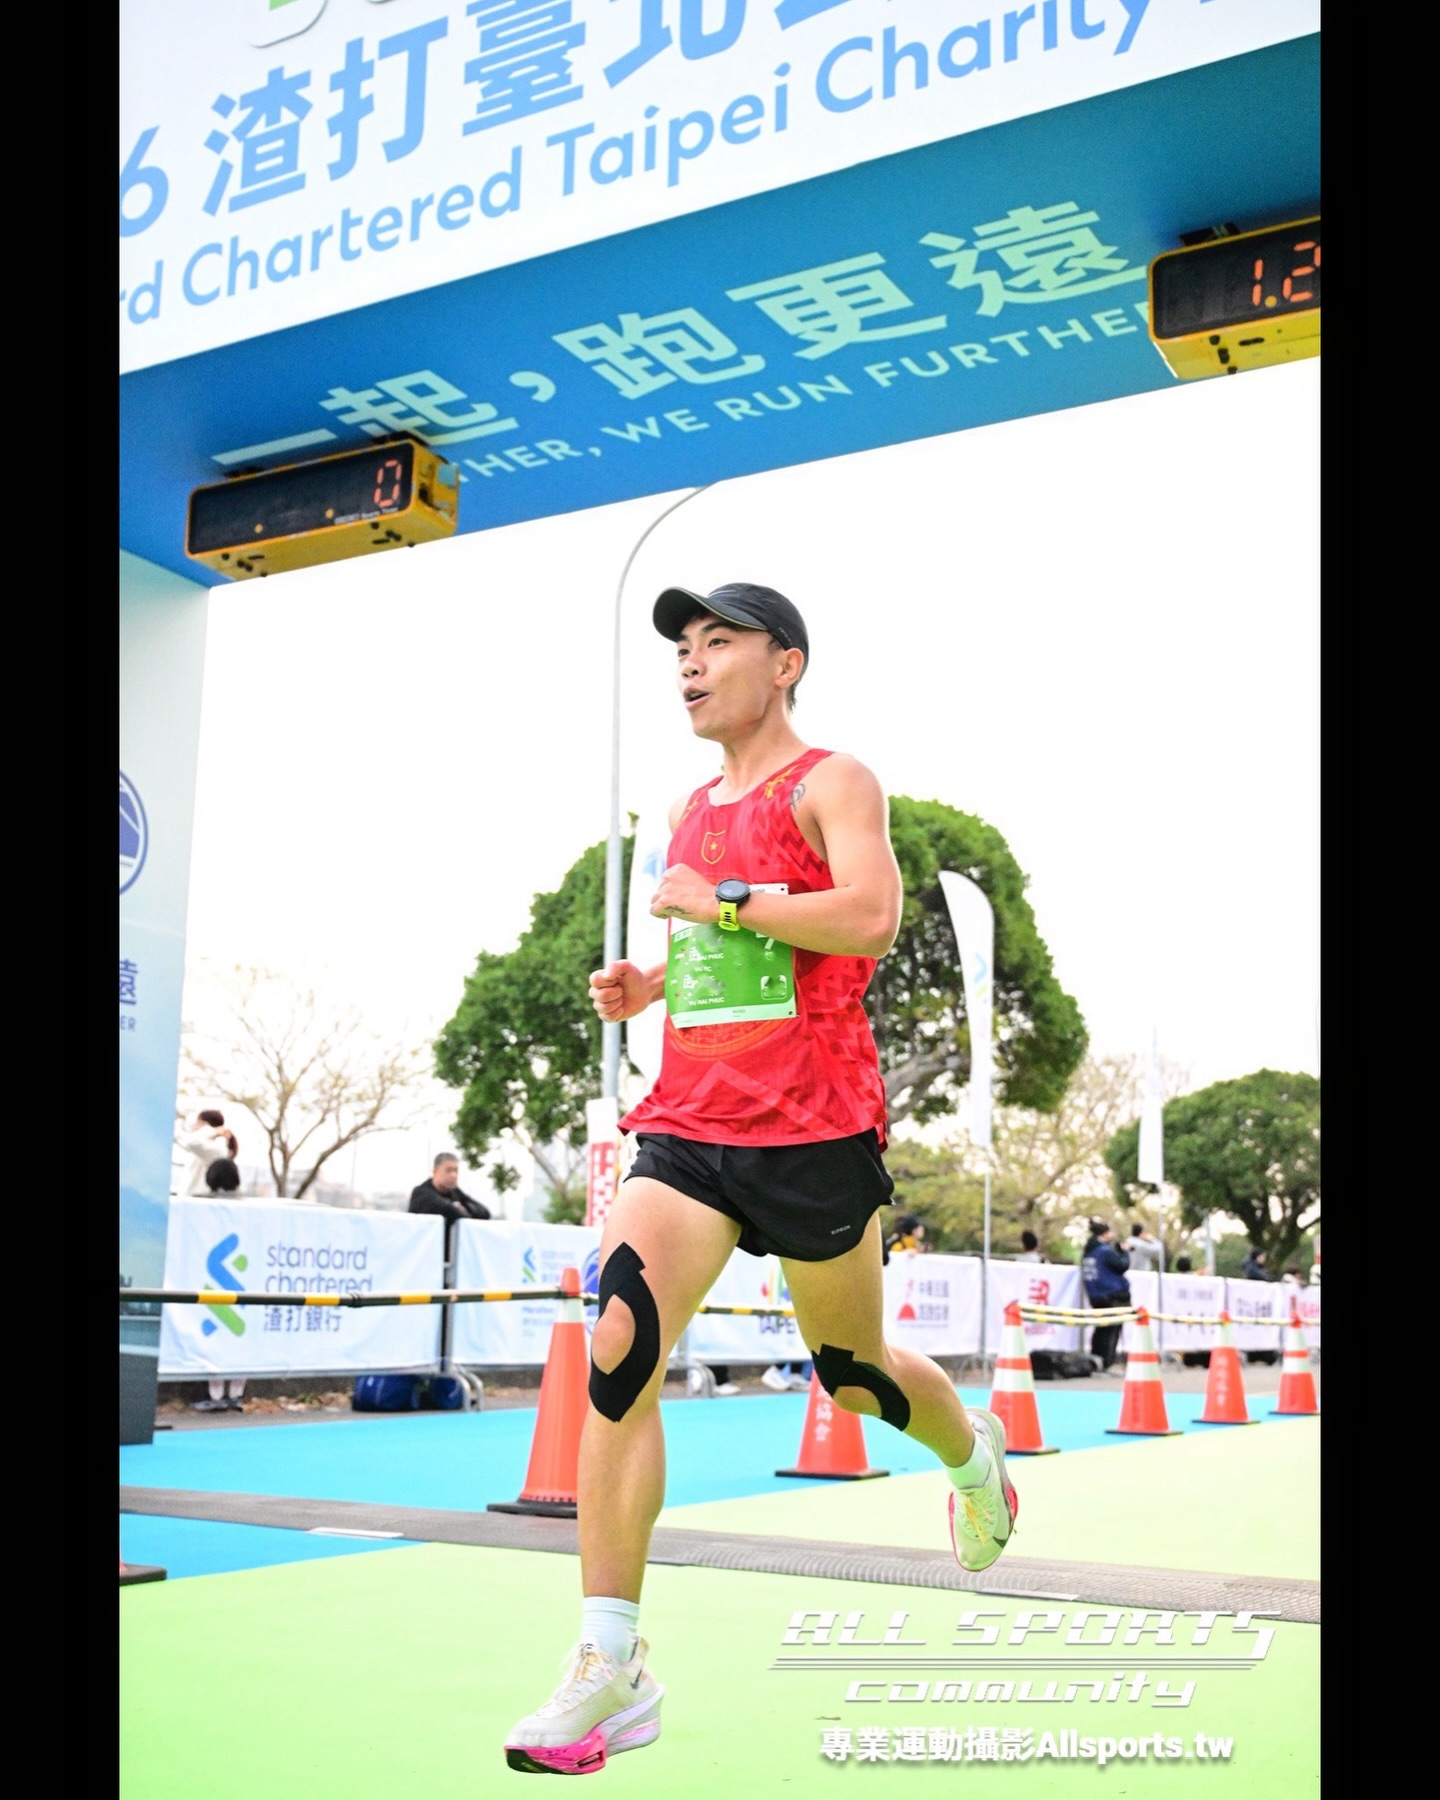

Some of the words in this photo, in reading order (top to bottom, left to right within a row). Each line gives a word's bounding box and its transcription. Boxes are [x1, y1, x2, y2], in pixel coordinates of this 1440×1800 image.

[202, 0, 893, 217] 渣打臺北
[120, 260, 164, 326] d
[181, 145, 523, 307] Chartered
[545, 62, 791, 198] Taipei
[815, 0, 1152, 114] Charity
[458, 437, 602, 483] HER,
[601, 407, 709, 444] WE
[713, 374, 854, 423] RUN
[374, 459, 402, 507] 0
[265, 1241, 368, 1270] standard
[265, 1270, 374, 1293] chartered
[263, 1304, 343, 1332] 渣打銀行
